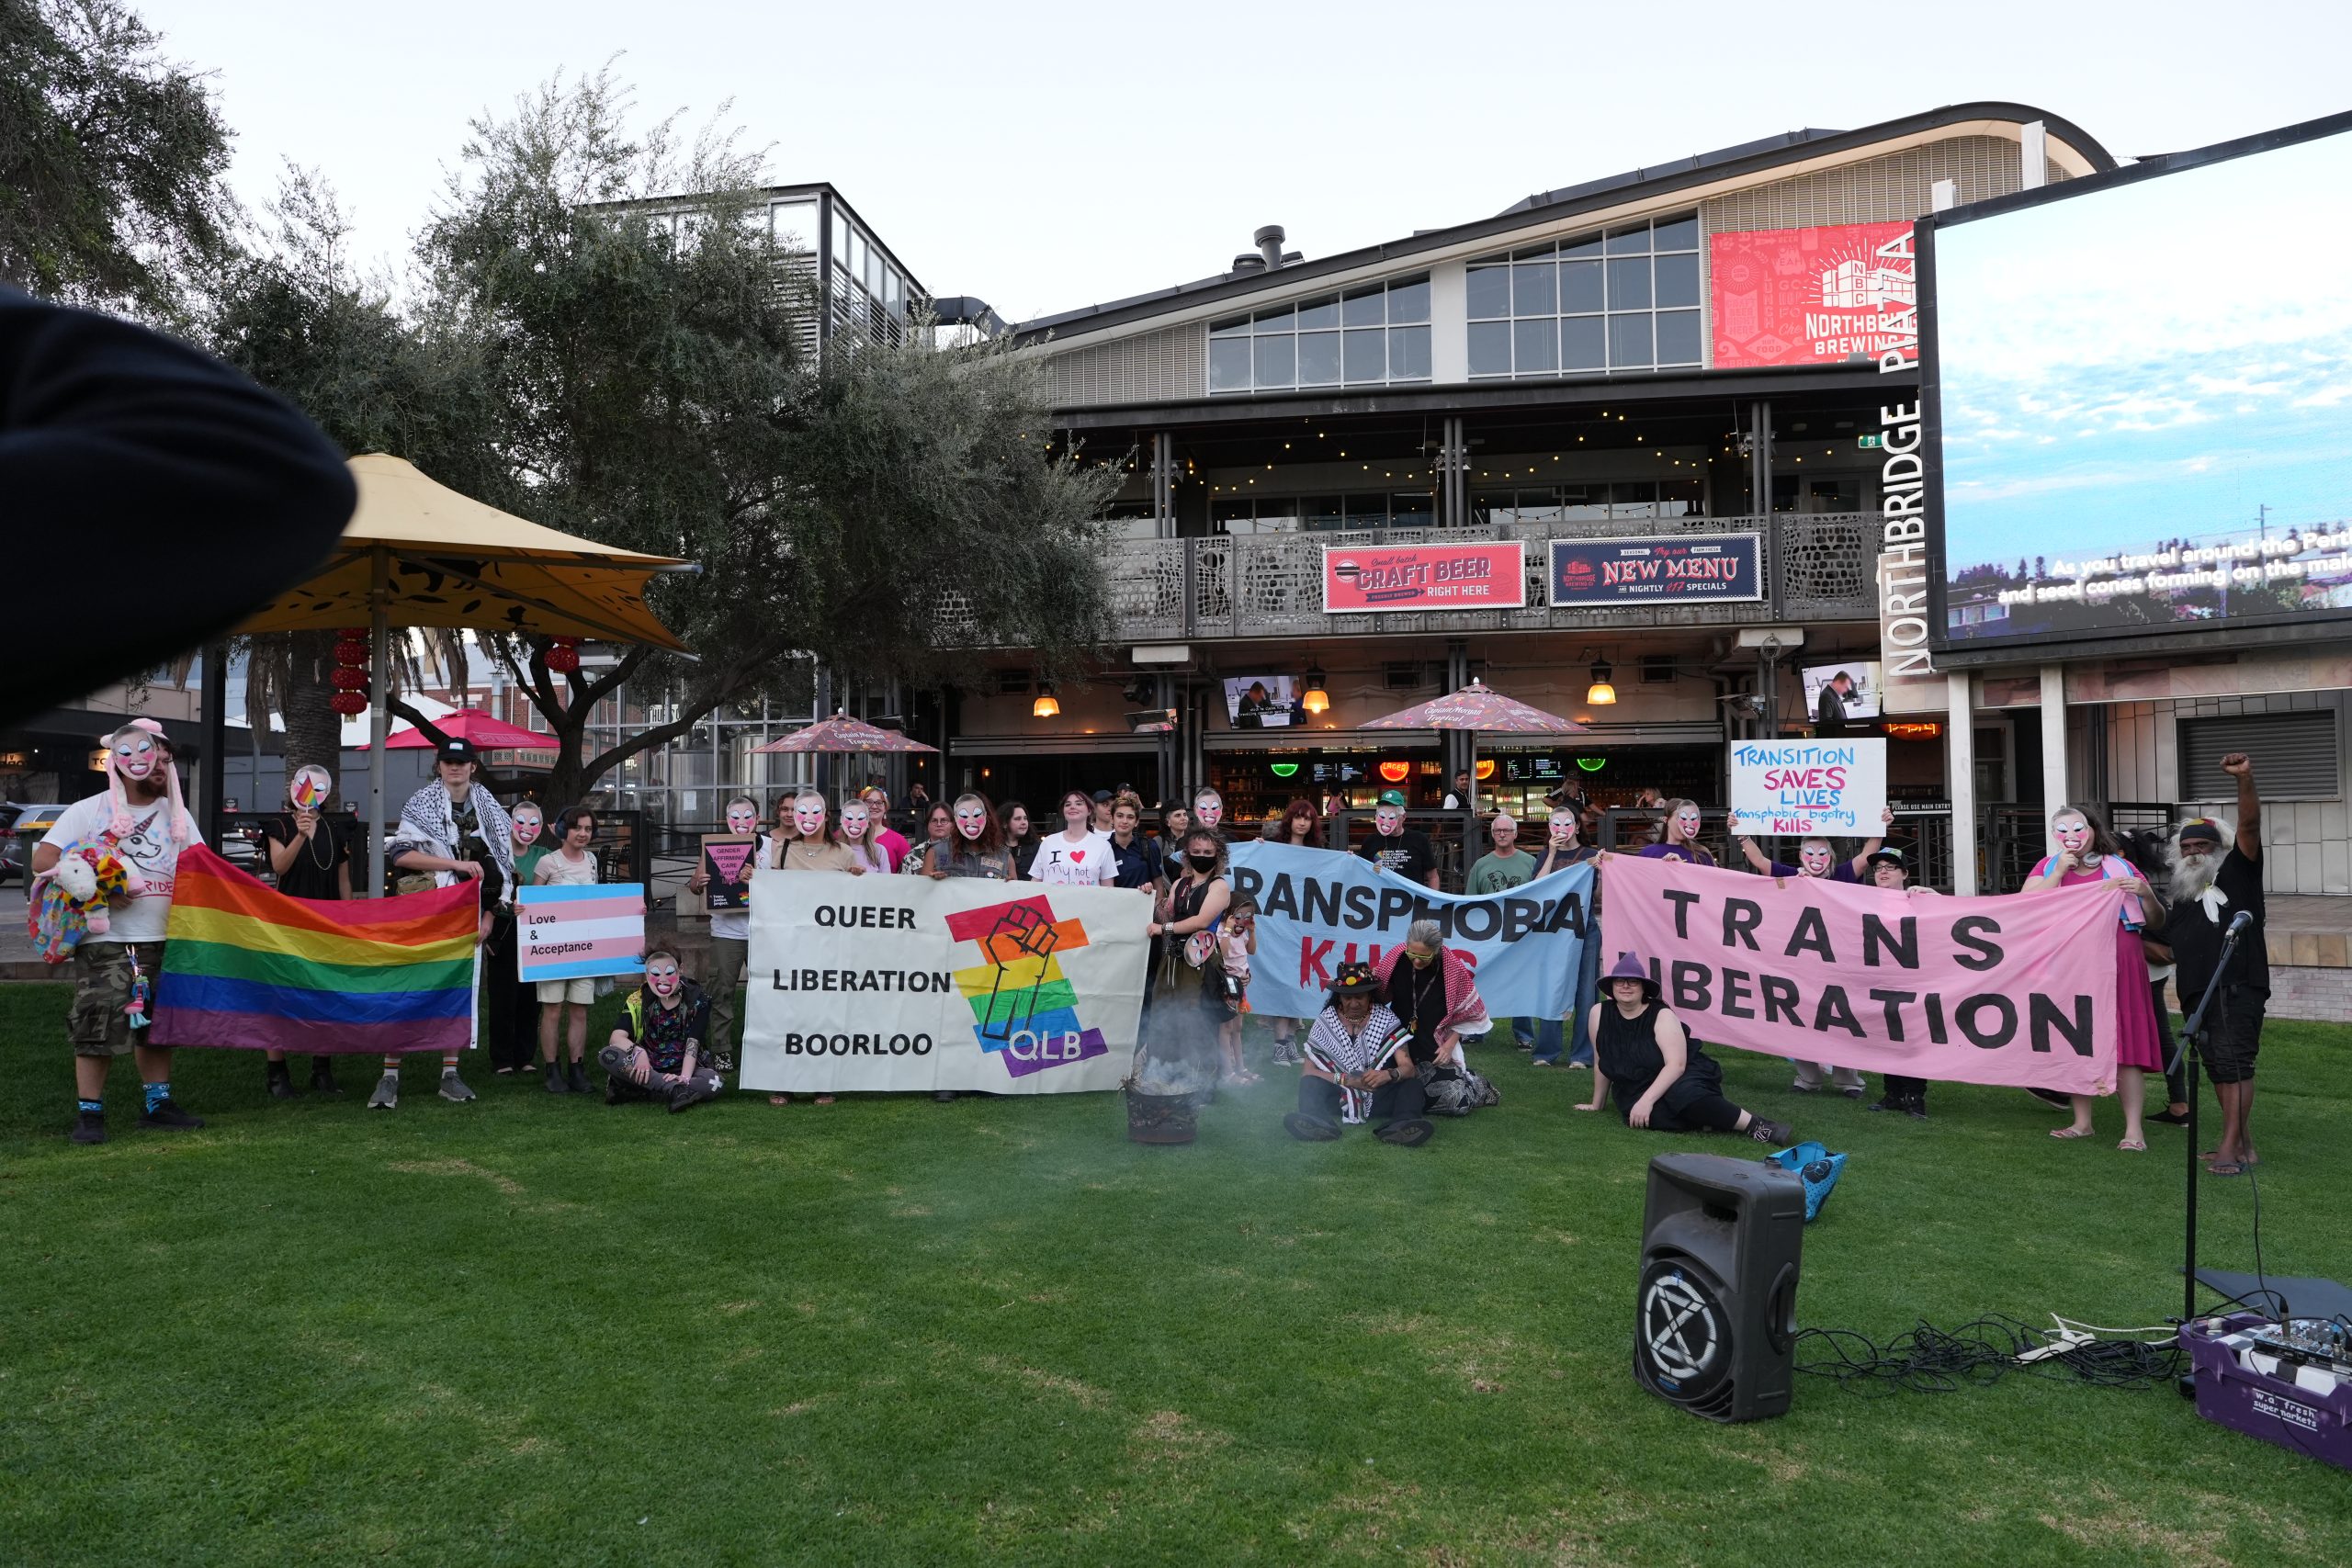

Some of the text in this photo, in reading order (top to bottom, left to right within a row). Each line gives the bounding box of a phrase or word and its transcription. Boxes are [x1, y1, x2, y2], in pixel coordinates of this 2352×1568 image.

[1876, 230, 1919, 374] PIAZZA
[1756, 344, 1781, 354] FOOD
[1881, 400, 1930, 676] NORTHBRIDGE
[1371, 553, 1418, 567] Small batch
[1654, 546, 1668, 559] Try
[2052, 560, 2075, 576] As
[2080, 558, 2115, 578] you
[2120, 547, 2176, 569] travel
[2182, 538, 2255, 563] around
[2260, 536, 2297, 552] the
[1356, 557, 1491, 591] CRAFT BEER
[1601, 557, 1739, 586] NEW MENU
[1997, 583, 2031, 603] and
[2036, 579, 2081, 599] seed
[2086, 577, 2143, 594] cones
[2145, 569, 2227, 588] forming
[2232, 566, 2259, 581] on
[2265, 558, 2301, 577] the
[1427, 584, 1489, 597] RIGHT HERE
[1629, 584, 1664, 592] NIGHTLY
[1666, 581, 1685, 592] $17
[1686, 582, 1726, 591] SPECIALS
[1424, 706, 1482, 716] Captain Morgan
[1735, 745, 1854, 766] TRANSITION
[1383, 762, 1407, 773] LAGER
[1764, 766, 1847, 791] SAVES
[1780, 789, 1841, 807] LIVES
[1734, 806, 1856, 828] Transphobic bigotry
[1773, 818, 1813, 833] Kills
[1049, 851, 1061, 864] I
[1075, 866, 1091, 878] not
[1225, 866, 1585, 942] RANSPHOBIA
[529, 915, 556, 925] Love
[814, 905, 917, 930] QUEER
[530, 930, 538, 941] &
[1662, 888, 2004, 971] TRANS
[530, 942, 593, 955] Acceptance
[773, 968, 951, 993] LIBERATION
[1619, 952, 2094, 1057] IBERATION
[786, 1032, 933, 1056] BOORLOO
[1009, 1031, 1081, 1063] QLB
[2254, 1400, 2317, 1427] supermarkets
[2284, 1401, 2315, 1418] fresh
